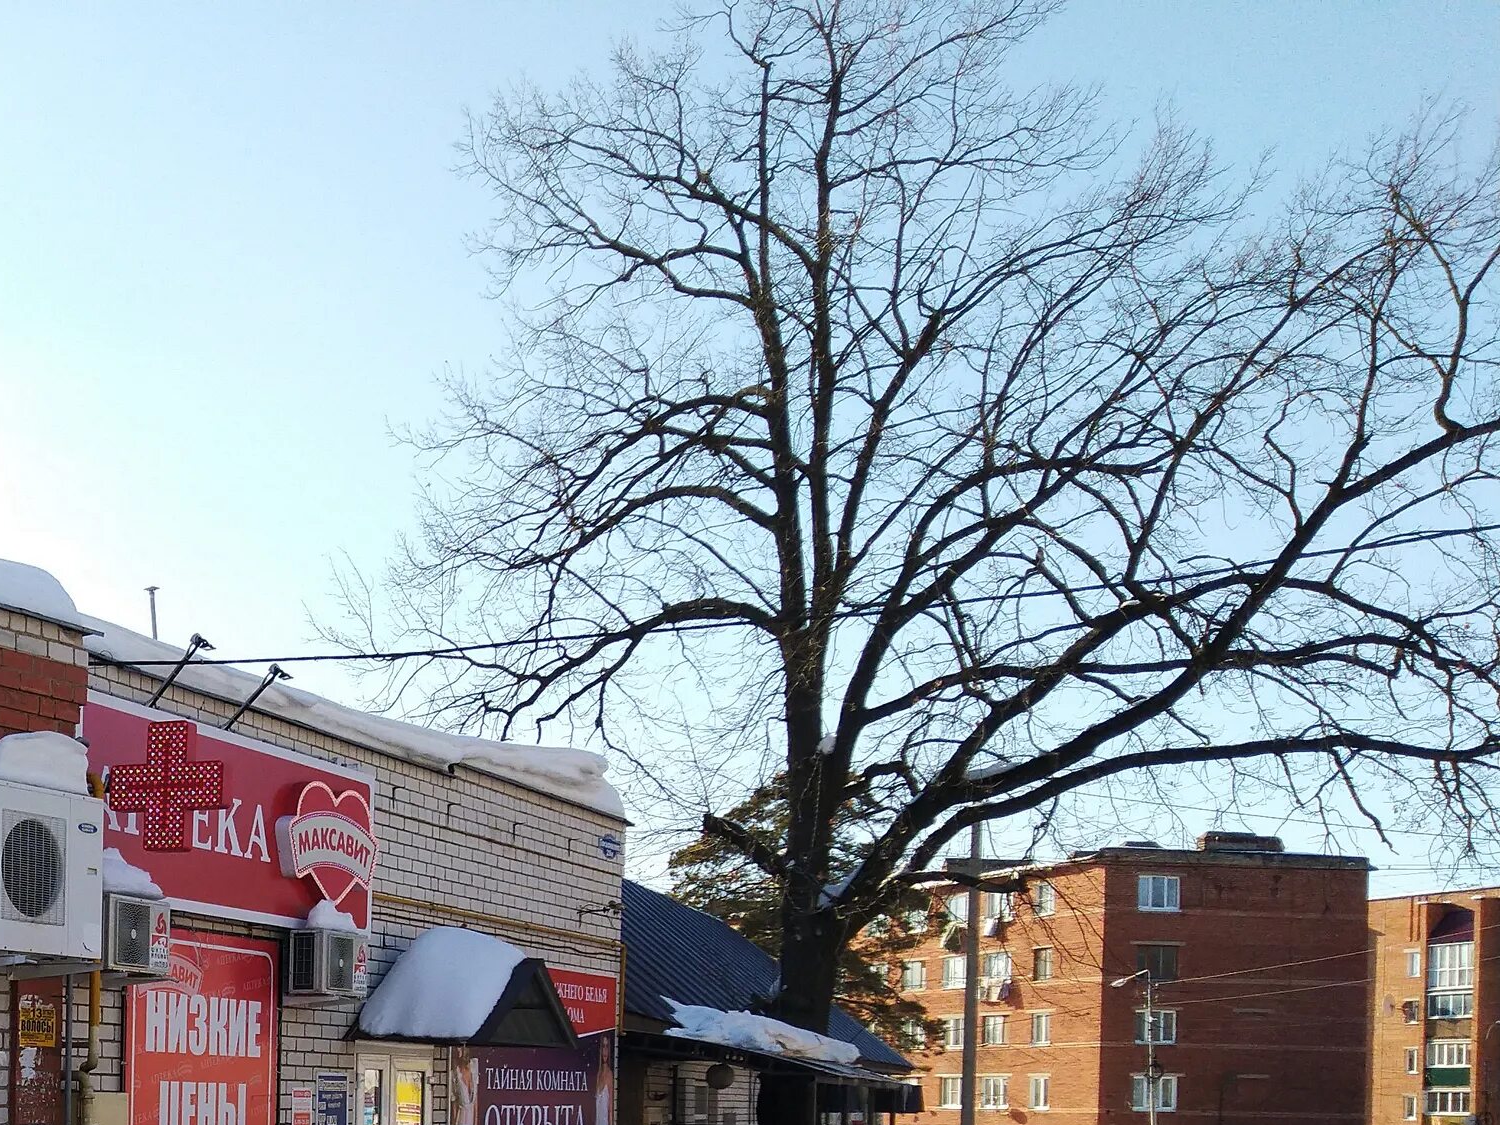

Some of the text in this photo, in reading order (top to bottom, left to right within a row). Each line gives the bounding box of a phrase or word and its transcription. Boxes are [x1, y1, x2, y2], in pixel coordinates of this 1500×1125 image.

[298, 826, 372, 868] МАКСАВИТ
[585, 986, 607, 1003] БЕЛЬЯ
[30, 1008, 42, 1019] 13
[145, 990, 262, 1058] НИЗКИЕ
[21, 1020, 54, 1033] ВОЛОСЫ
[485, 1064, 588, 1092] ТАЙНАЯ КОМНАТА
